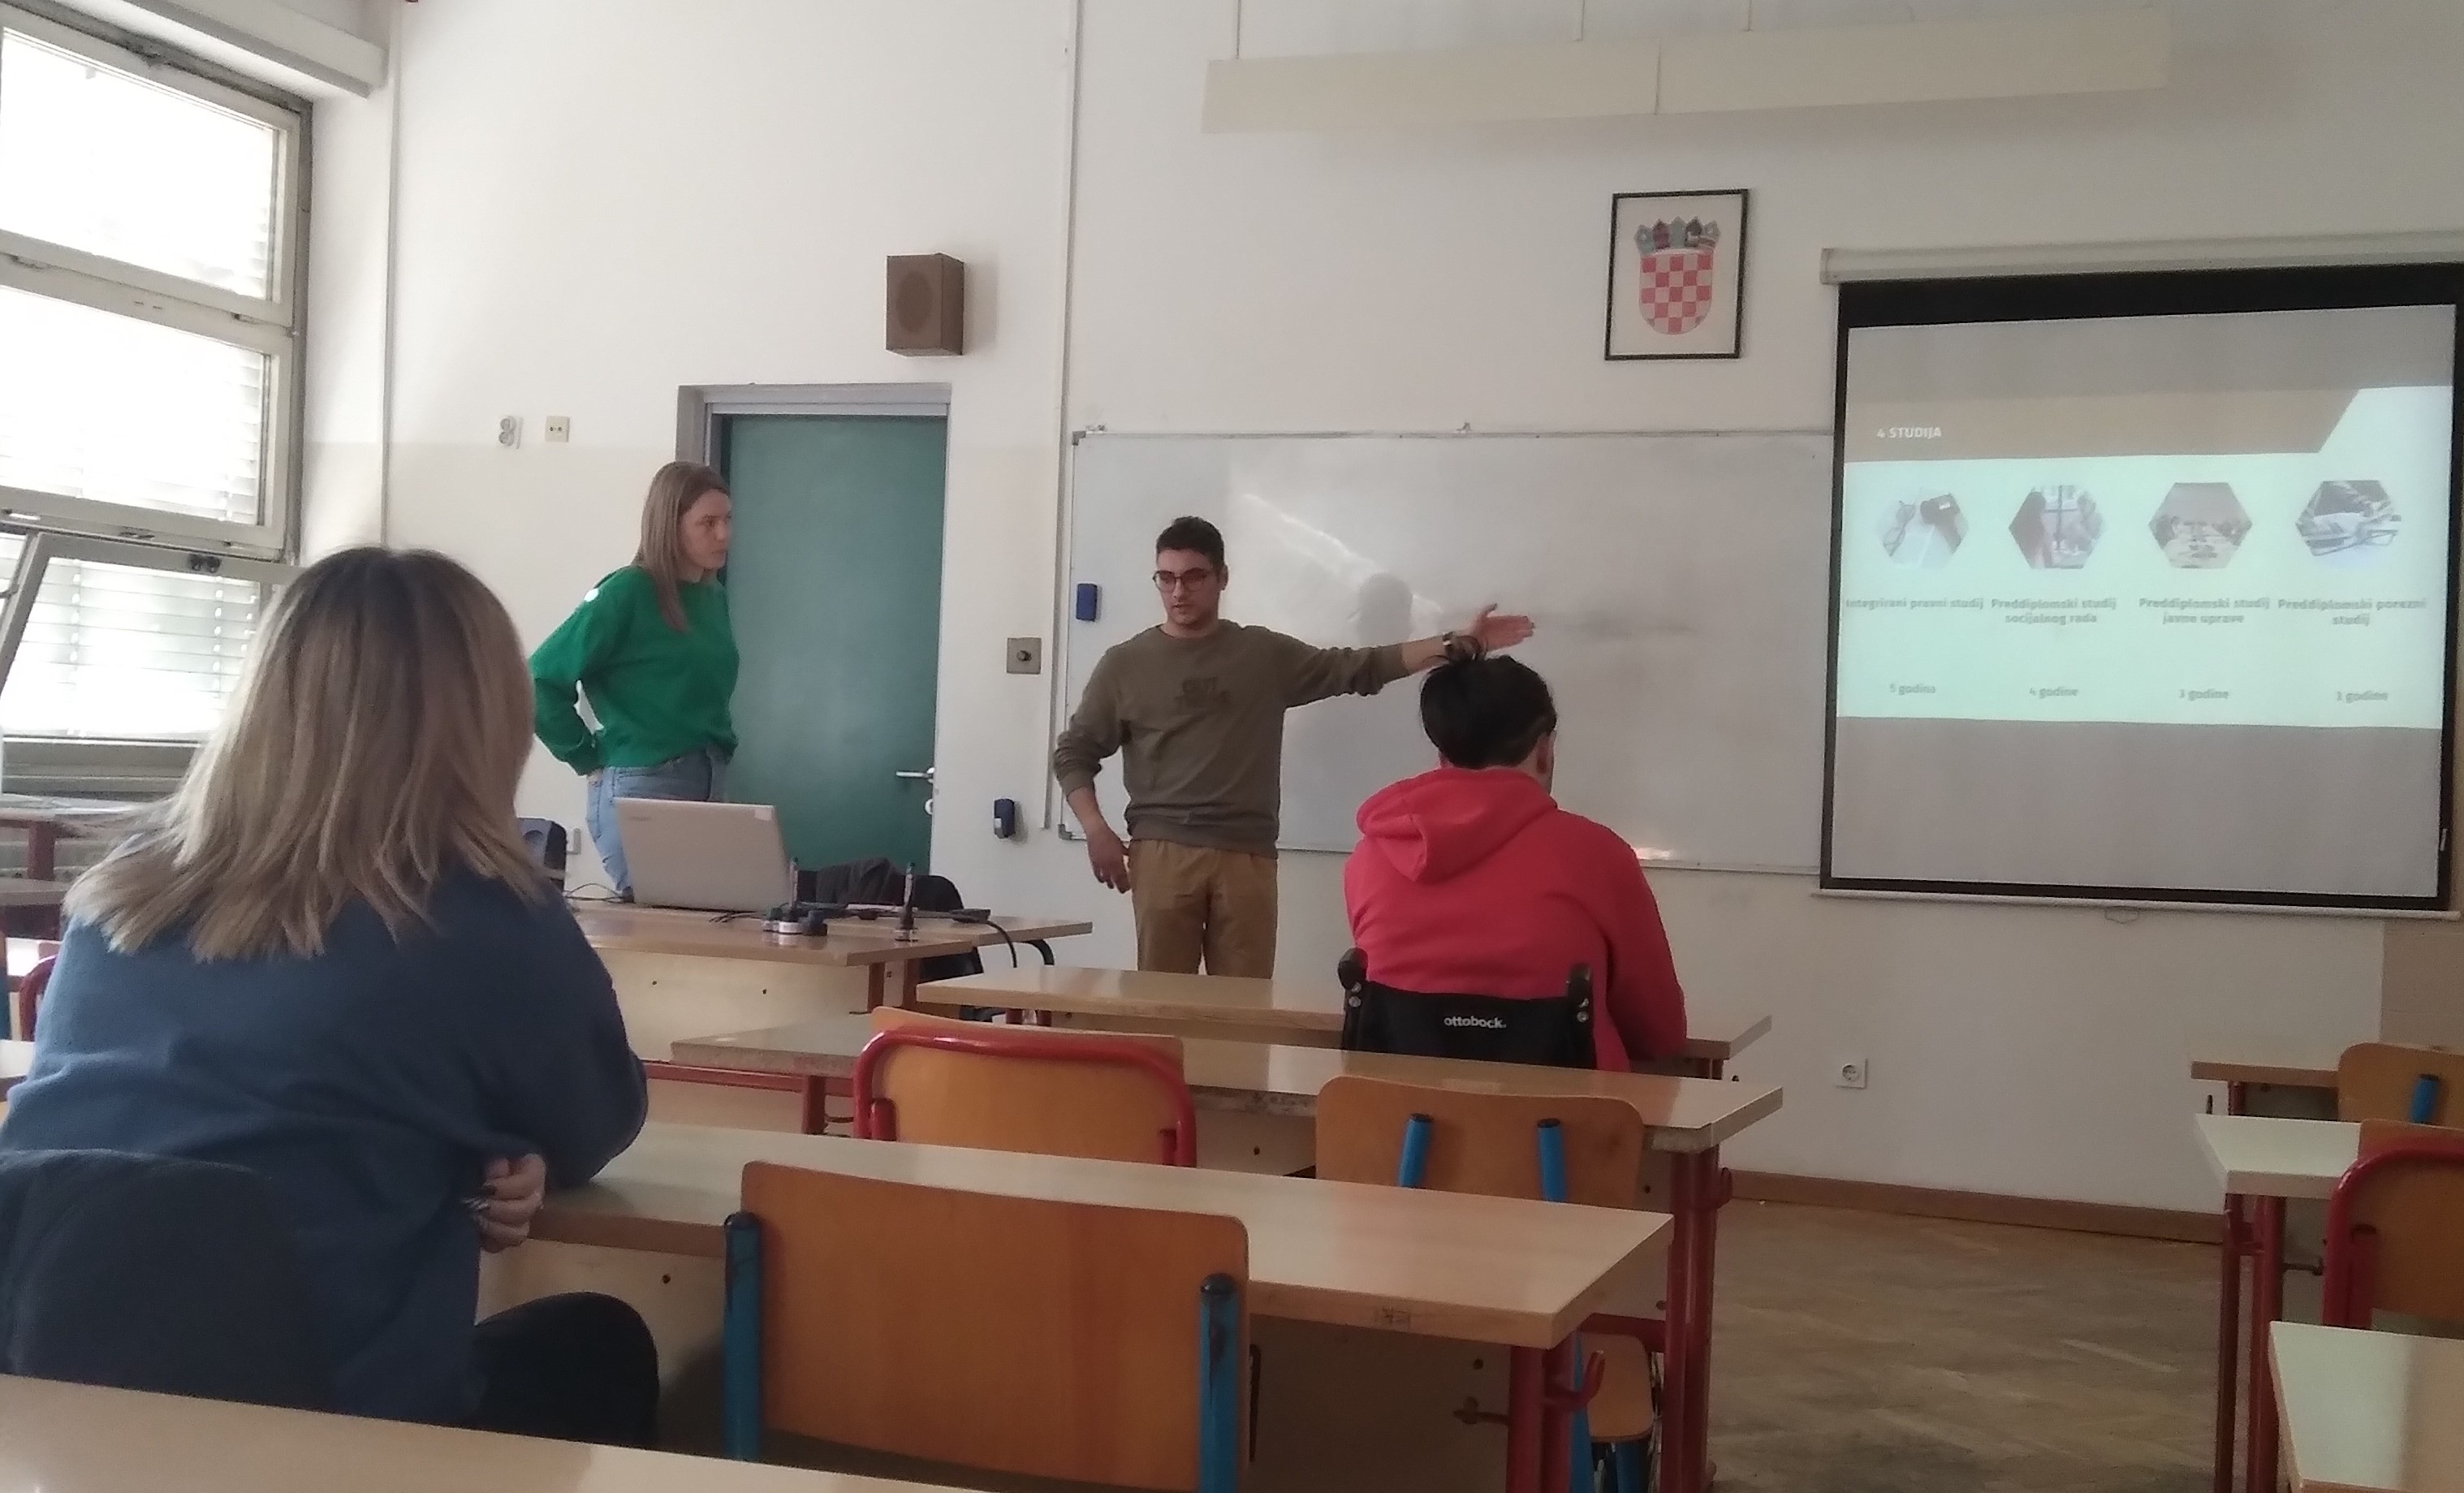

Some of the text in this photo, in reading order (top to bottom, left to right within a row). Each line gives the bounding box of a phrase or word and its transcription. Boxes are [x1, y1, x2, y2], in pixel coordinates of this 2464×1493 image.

[1876, 426, 1942, 439] 4 STUDIJA
[1950, 598, 1984, 611] studij
[1991, 598, 2117, 611] Preddiplomski studij
[2139, 598, 2229, 611] Preddiplomski
[2005, 613, 2097, 625] socijalnog rada
